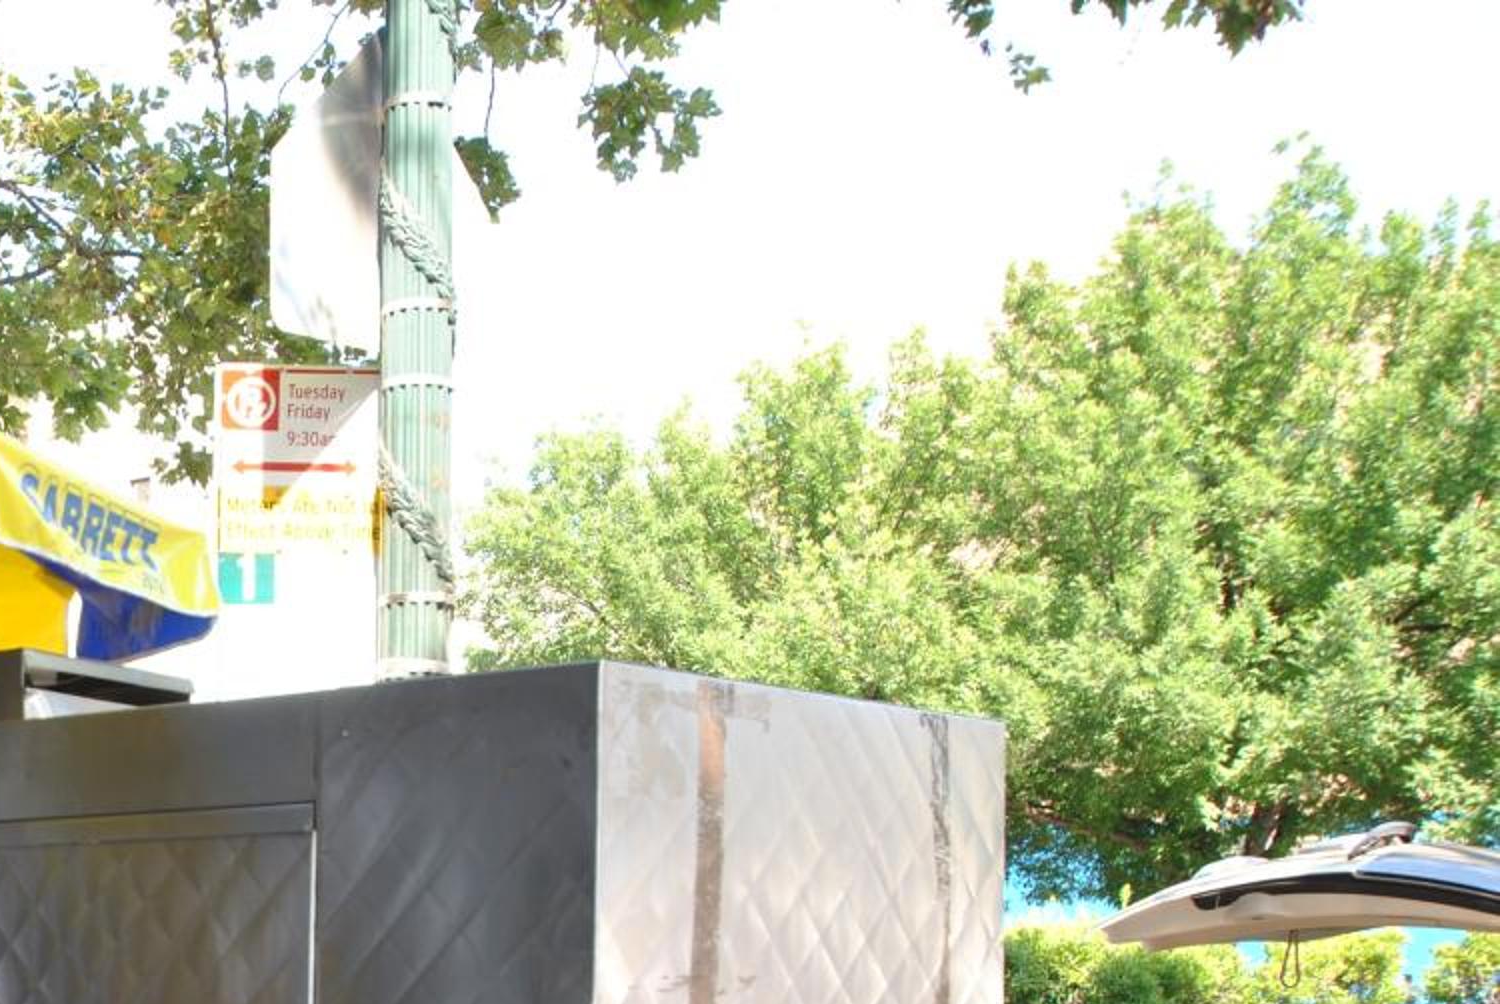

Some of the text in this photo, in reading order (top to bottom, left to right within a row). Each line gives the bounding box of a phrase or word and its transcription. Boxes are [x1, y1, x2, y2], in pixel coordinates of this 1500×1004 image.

[288, 383, 347, 402] Tuesday
[287, 402, 331, 421] Friday
[20, 469, 161, 572] SABRETT
